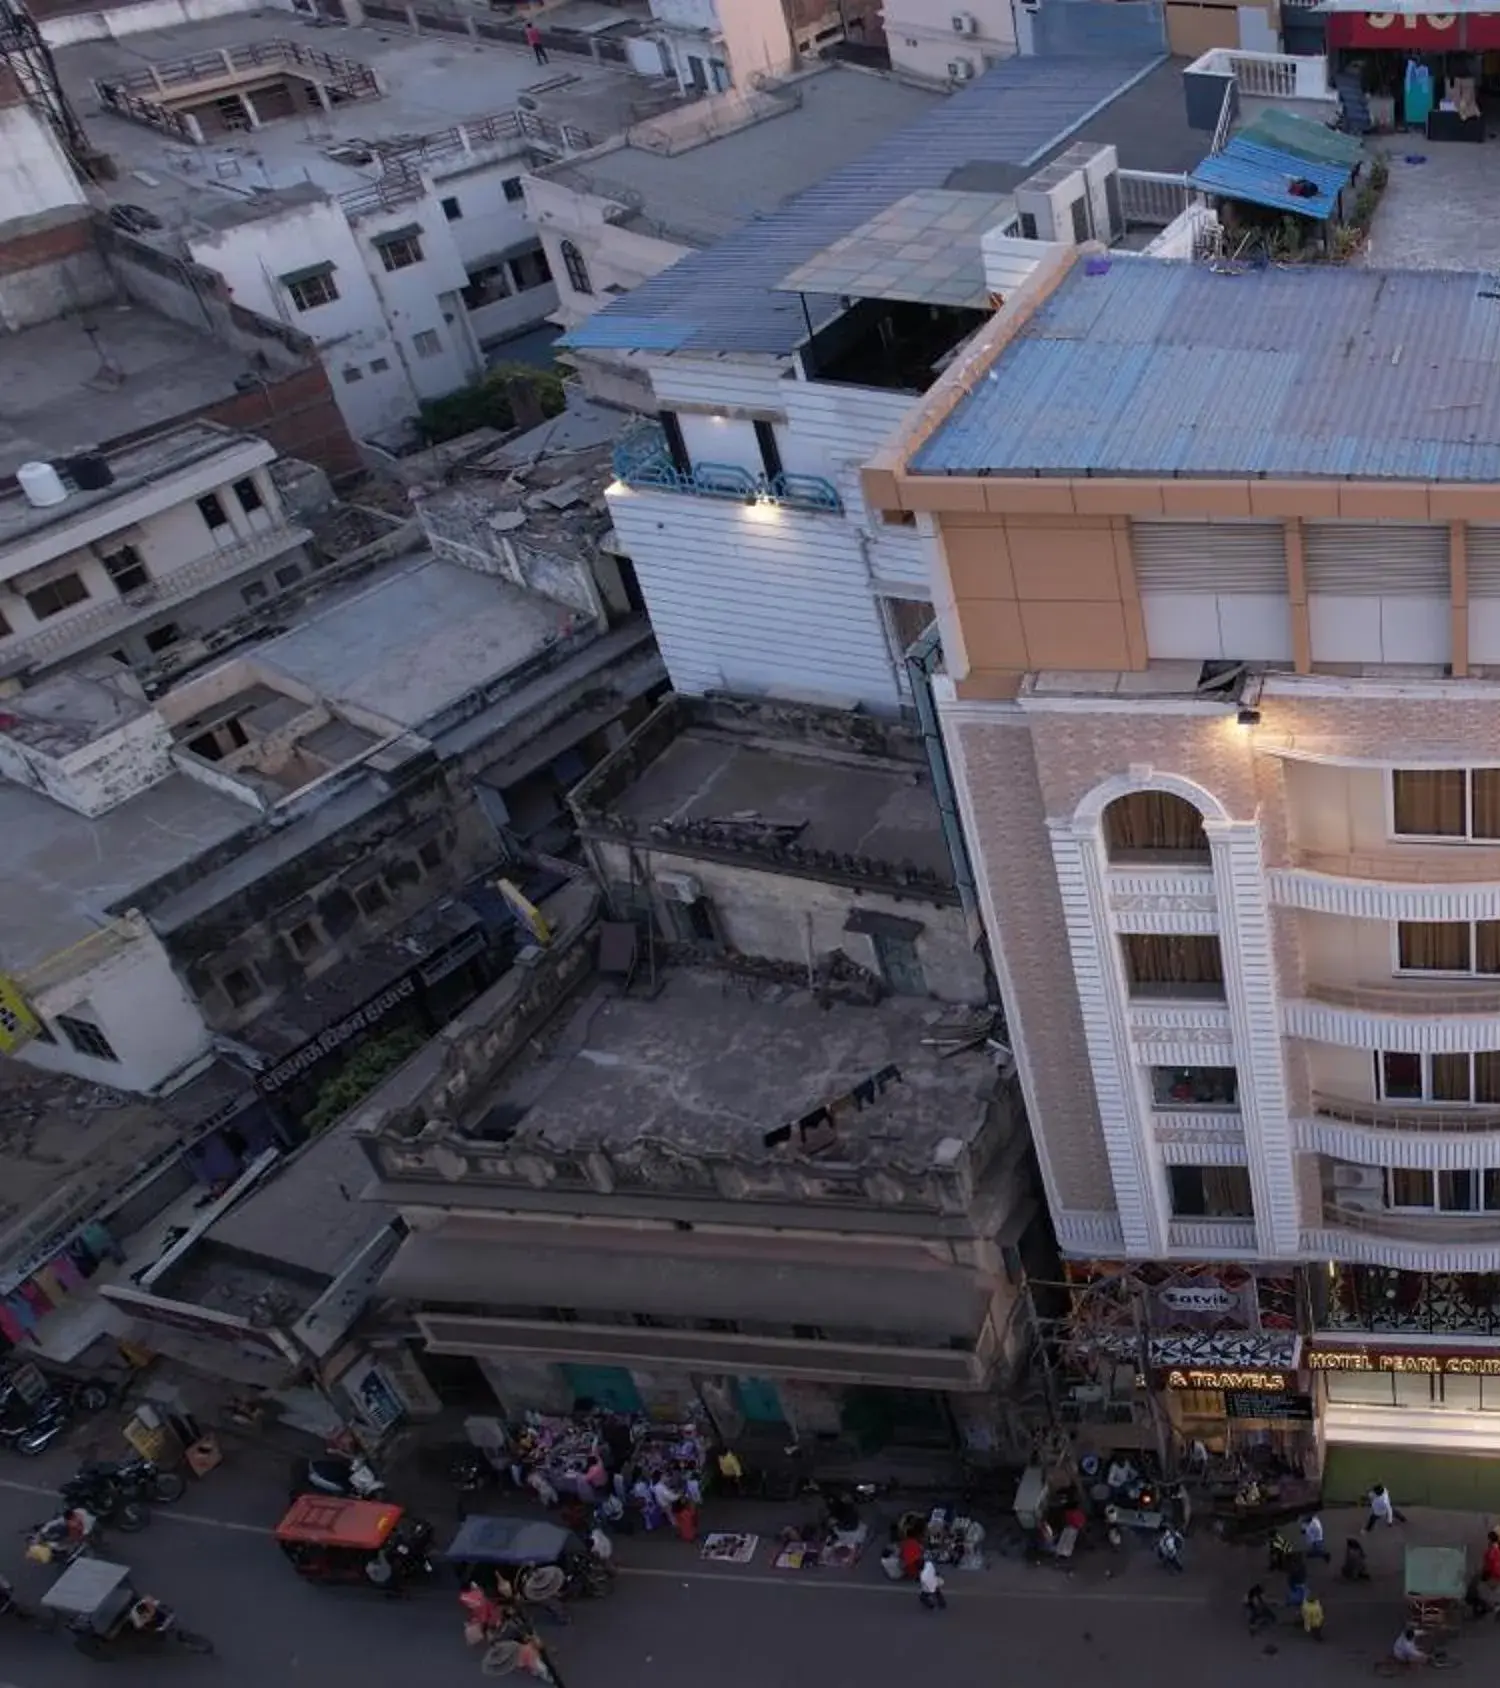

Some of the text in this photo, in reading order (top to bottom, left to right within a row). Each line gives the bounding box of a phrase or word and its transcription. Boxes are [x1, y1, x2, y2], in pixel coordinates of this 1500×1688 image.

[1308, 1352, 1373, 1370] HOTEL
[1379, 1354, 1441, 1372] PEARL
[1168, 1370, 1188, 1388] &
[1188, 1370, 1285, 1391] TRAVELS
